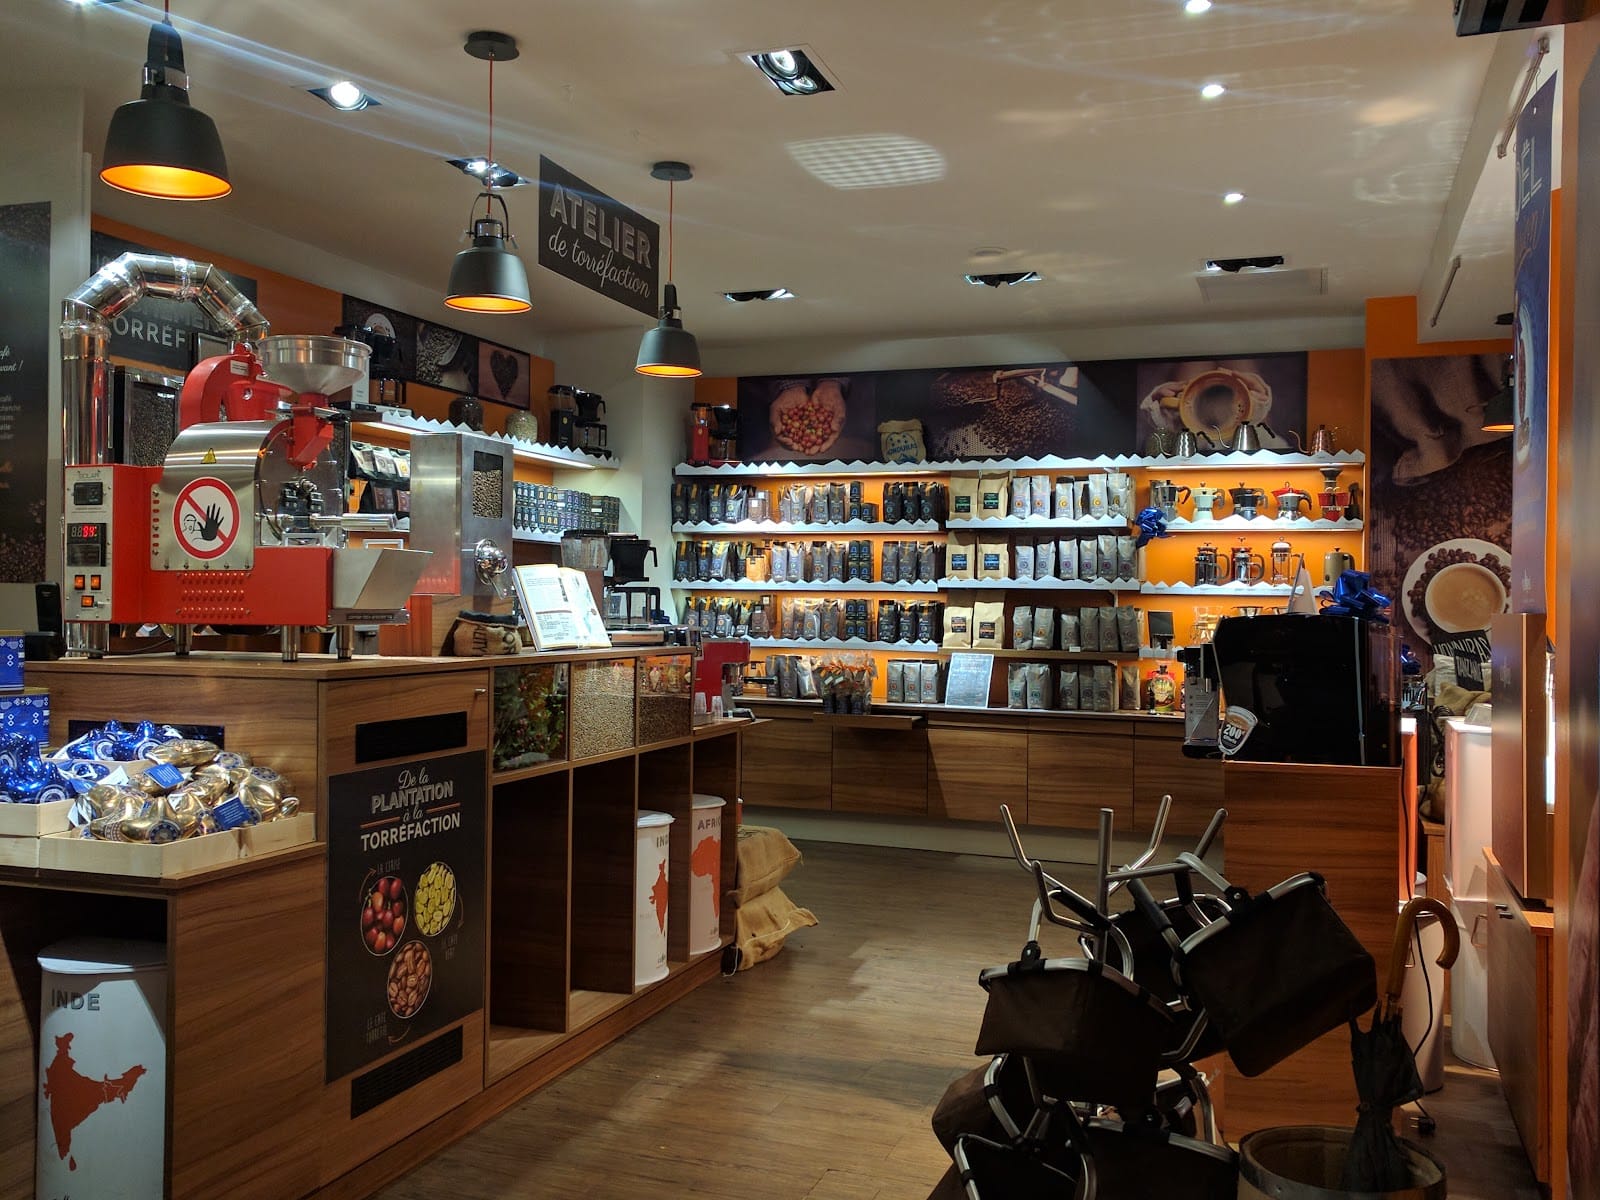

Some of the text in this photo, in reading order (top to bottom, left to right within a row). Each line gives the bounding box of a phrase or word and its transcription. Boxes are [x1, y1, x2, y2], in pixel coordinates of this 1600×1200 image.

[549, 183, 652, 270] ATELIER
[548, 226, 650, 298] de torréfaction
[113, 315, 186, 349] ORRÉF
[398, 766, 429, 790] De la
[371, 780, 454, 814] PLANTATION
[412, 802, 424, 820] la
[360, 812, 461, 852] TORRÉFACTION
[51, 988, 101, 1012] INDE
